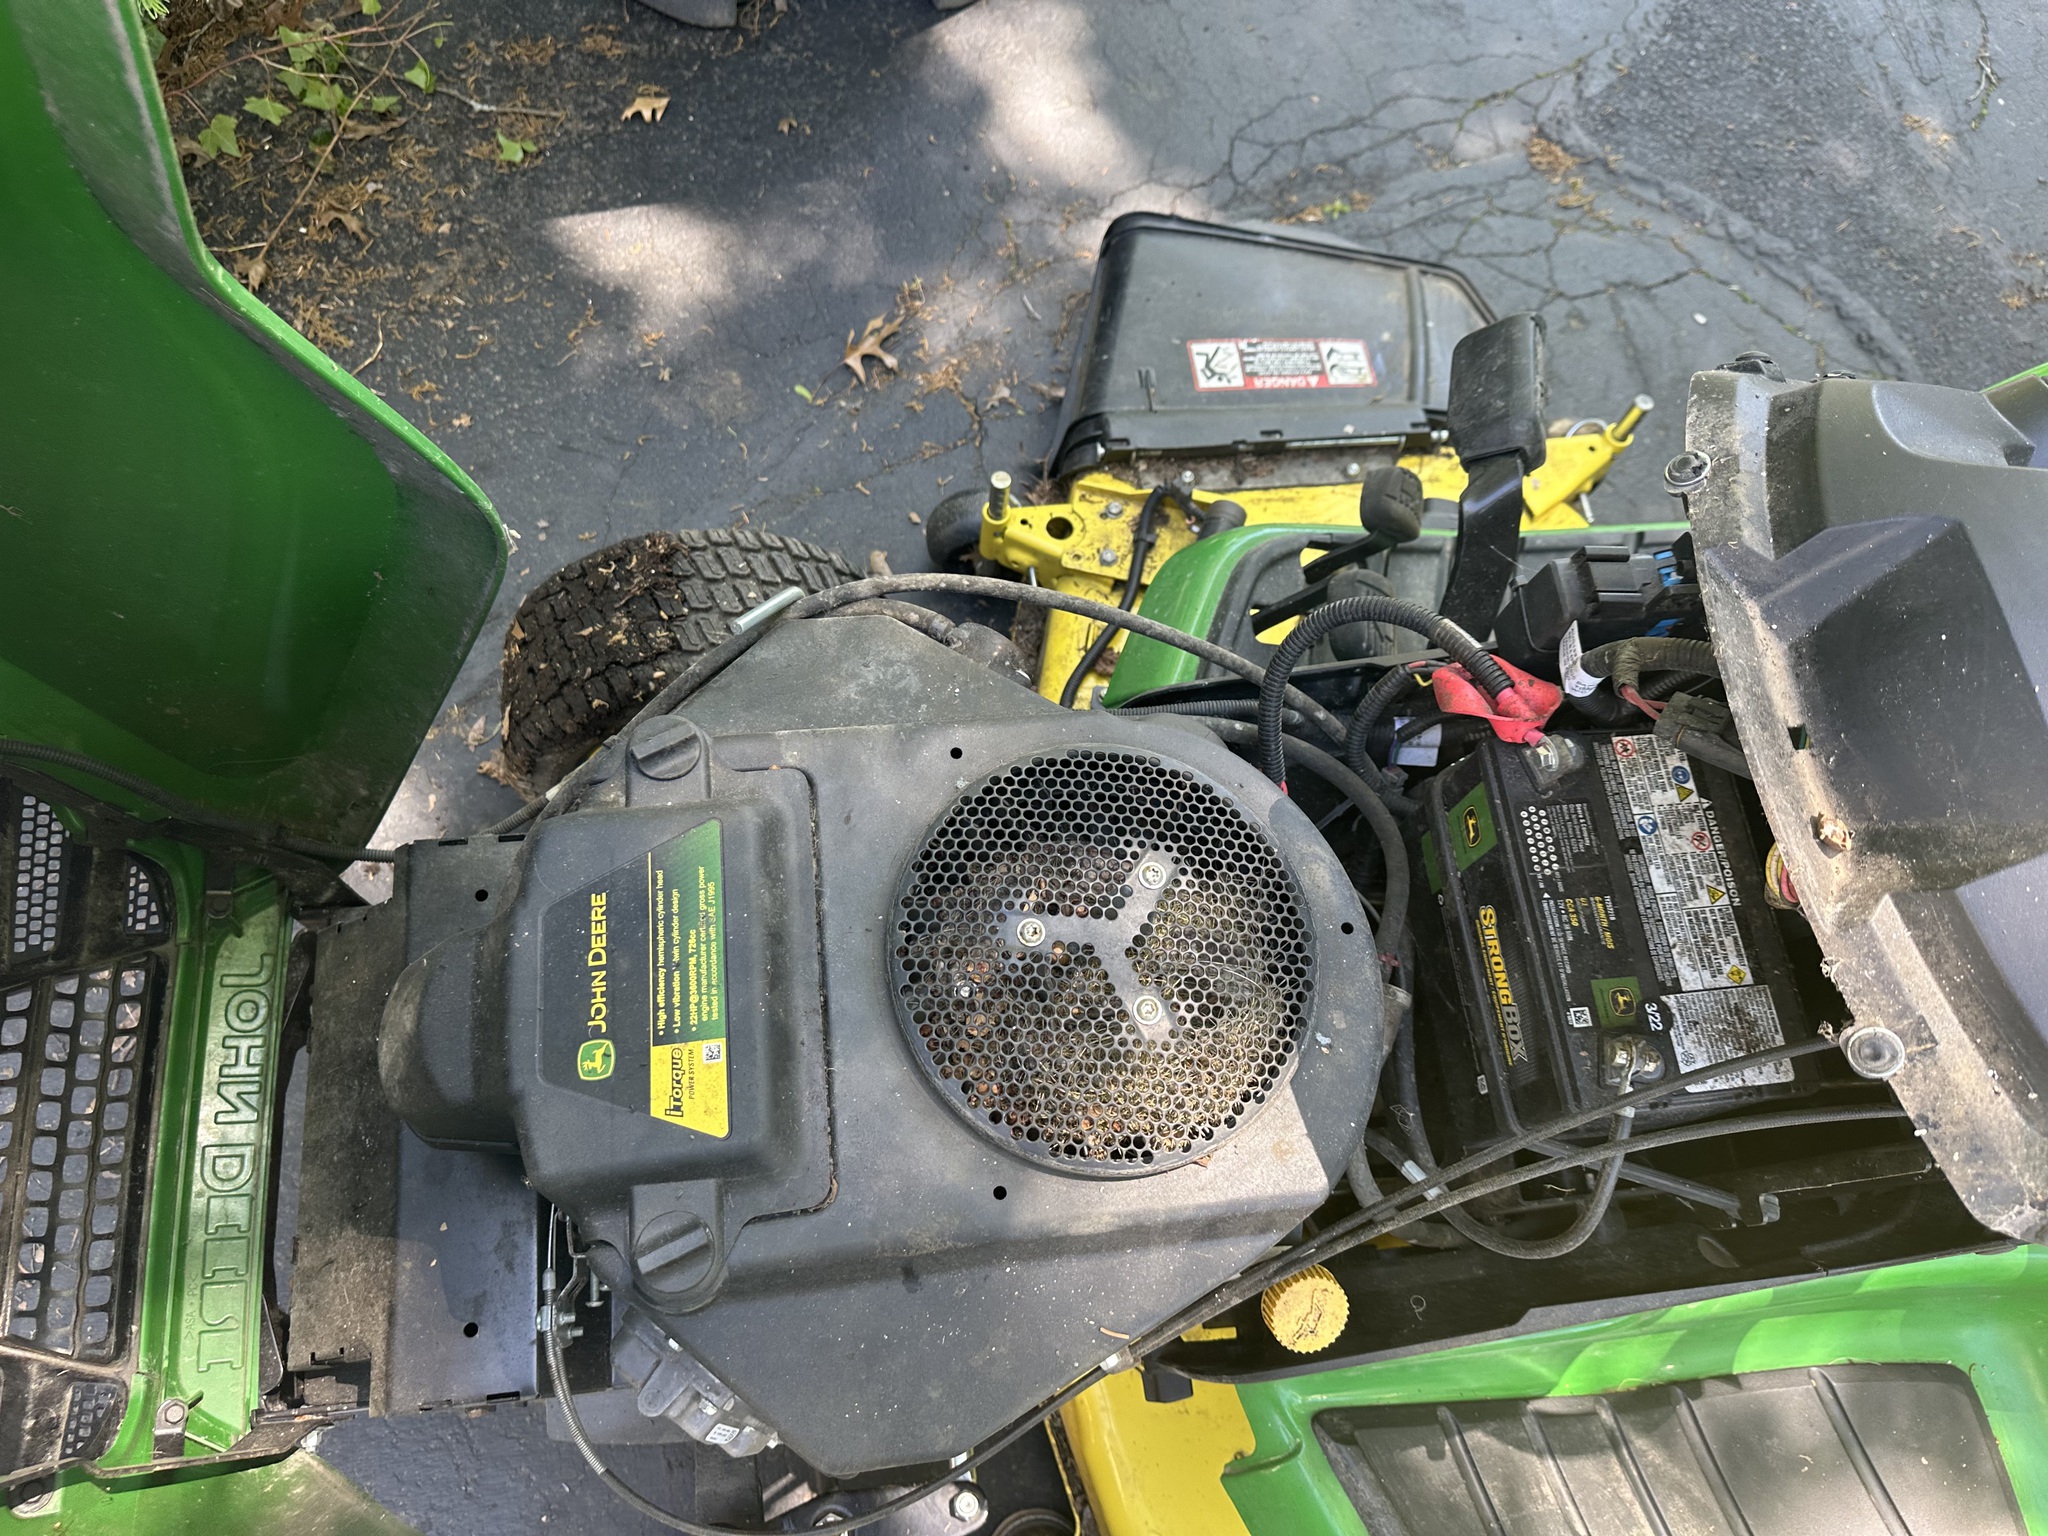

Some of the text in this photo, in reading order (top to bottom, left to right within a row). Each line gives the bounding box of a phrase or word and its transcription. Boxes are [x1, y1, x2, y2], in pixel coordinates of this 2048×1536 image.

[1705, 810, 1741, 906] DANGER/POISON
[698, 865, 706, 888] power
[671, 888, 680, 913] design
[698, 889, 706, 910] gross
[707, 881, 715, 904] J1995
[707, 906, 716, 922] SAE
[1565, 898, 1579, 927] CCA 350
[1594, 897, 1609, 927] 6-MONTH
[1603, 931, 1615, 948] MOIS
[671, 914, 680, 944] cylinder
[708, 924, 716, 940] with
[587, 892, 606, 1032] JOHN DEERE
[655, 869, 666, 1028] High efficiency hemispheric cylinder head
[708, 941, 718, 985] accordance
[698, 942, 707, 992] manufacturer
[672, 970, 680, 1007] vibration
[1478, 906, 1527, 1061] STRONGBOX
[672, 1008, 680, 1026] Low
[700, 994, 709, 1021] engine
[1644, 1002, 1662, 1031] 3/22
[664, 1047, 685, 1117] iTorque
